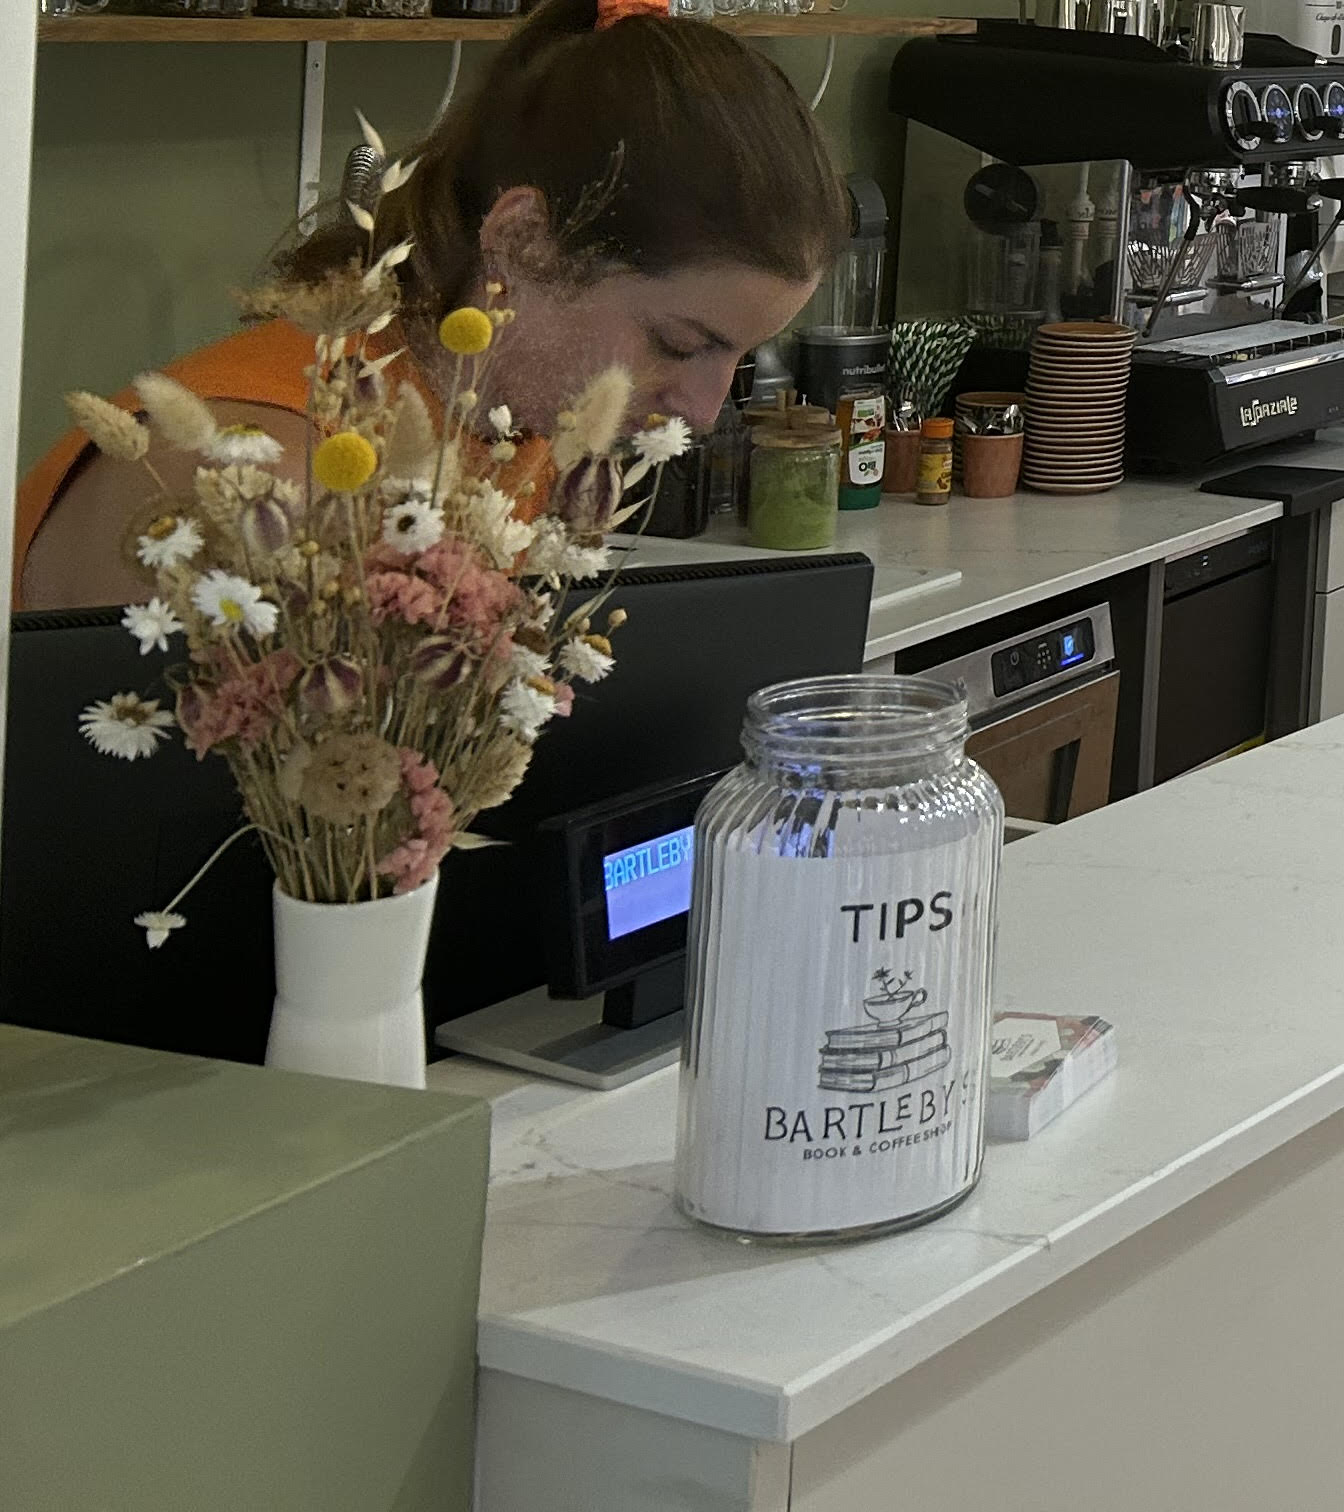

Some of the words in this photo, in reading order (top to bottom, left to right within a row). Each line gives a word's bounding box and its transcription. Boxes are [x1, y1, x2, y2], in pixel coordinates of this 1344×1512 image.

[840, 890, 954, 944] TIPS
[803, 1146, 848, 1160] BOOK
[852, 1145, 862, 1157] &
